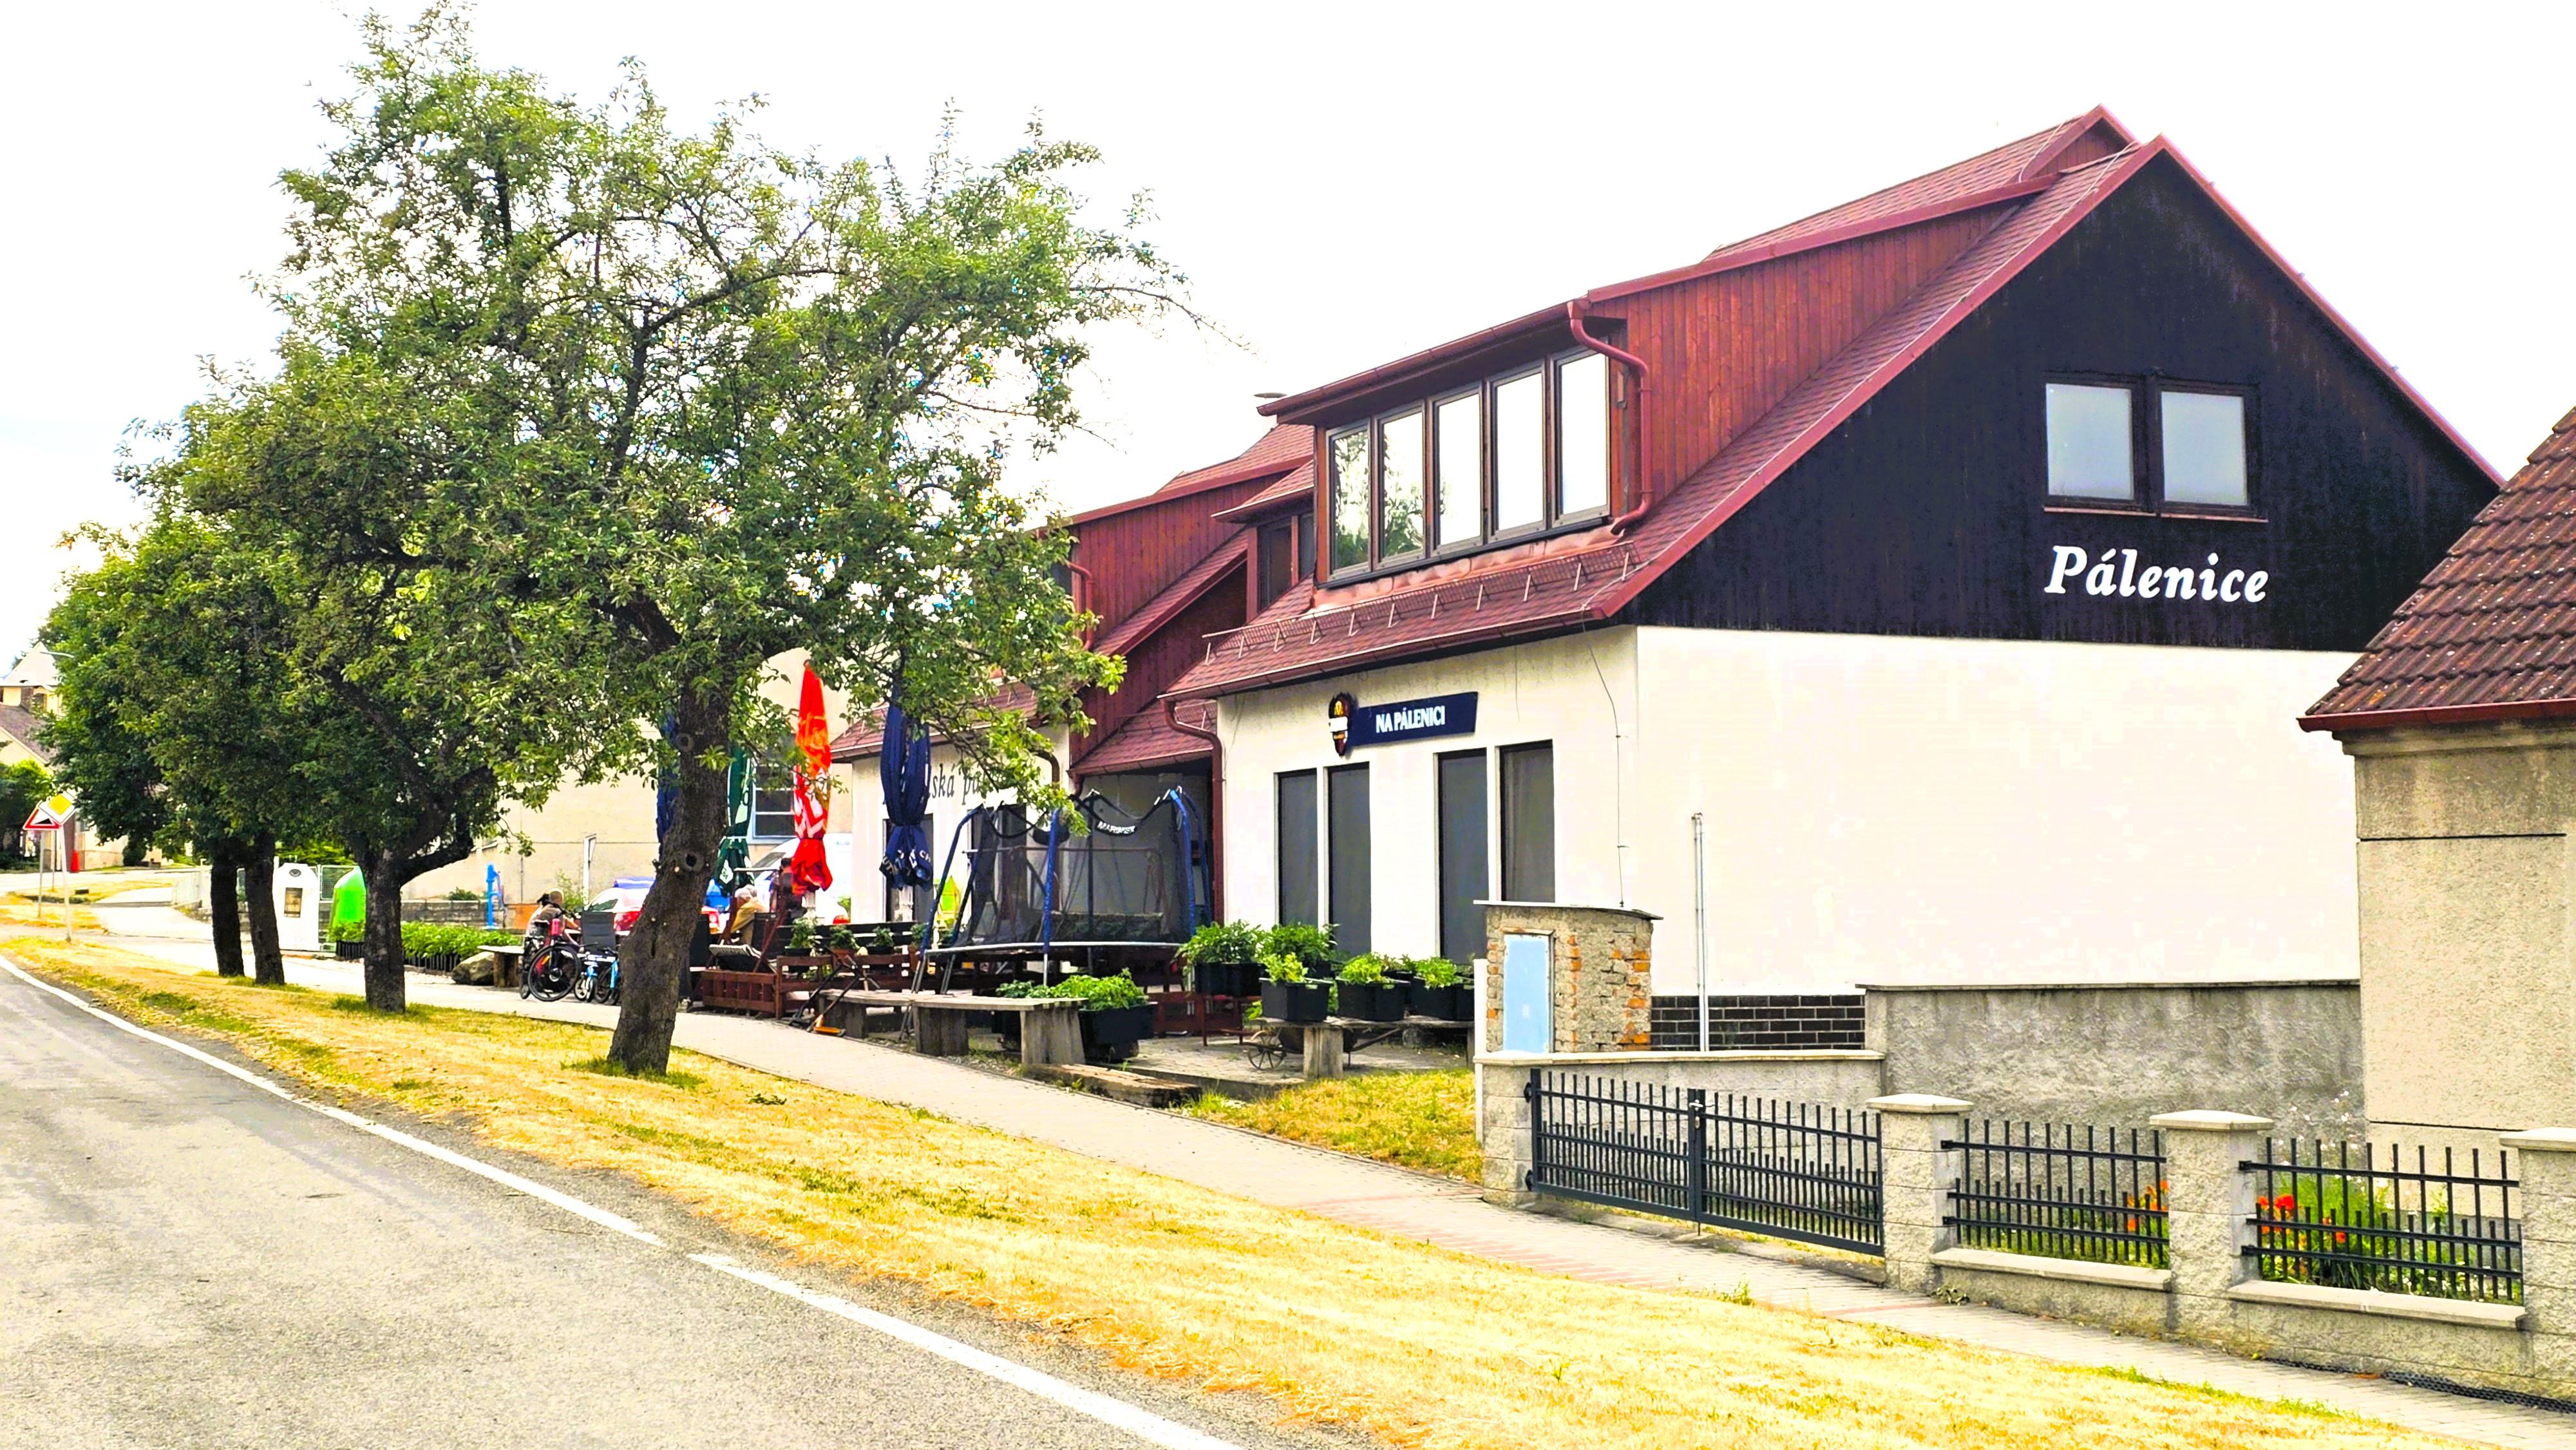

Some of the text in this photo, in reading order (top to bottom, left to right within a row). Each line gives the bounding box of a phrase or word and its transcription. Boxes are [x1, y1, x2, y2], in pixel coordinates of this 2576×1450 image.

[2043, 545, 2269, 603] Pálenice
[1376, 705, 1445, 733] NA PÁLENICI
